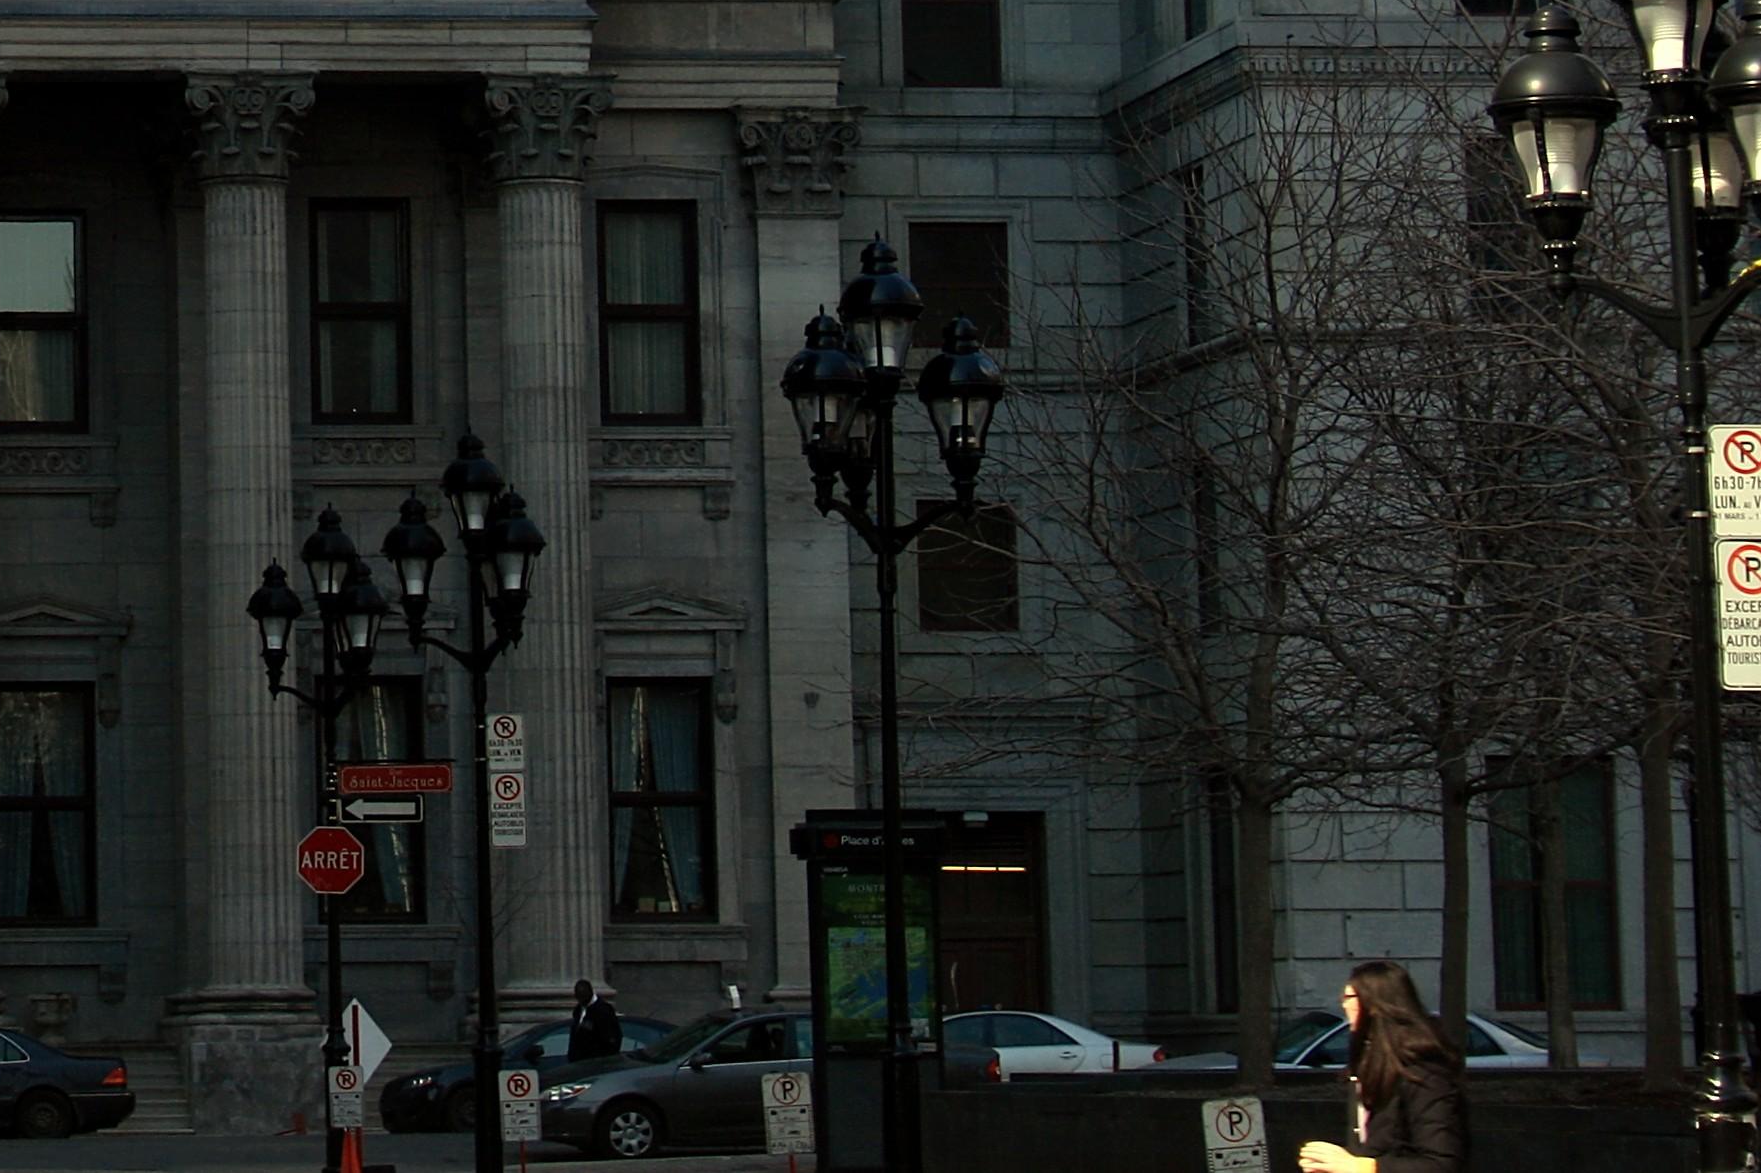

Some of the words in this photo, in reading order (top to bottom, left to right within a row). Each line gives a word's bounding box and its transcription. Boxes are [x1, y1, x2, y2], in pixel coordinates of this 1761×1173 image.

[1715, 495, 1741, 509] LUN.
[1726, 635, 1761, 647] AUTO
[1728, 652, 1761, 664] TOURIS
[350, 775, 444, 791] Saint-Jacques
[841, 835, 870, 846] Place
[301, 848, 360, 870] ARRÊT
